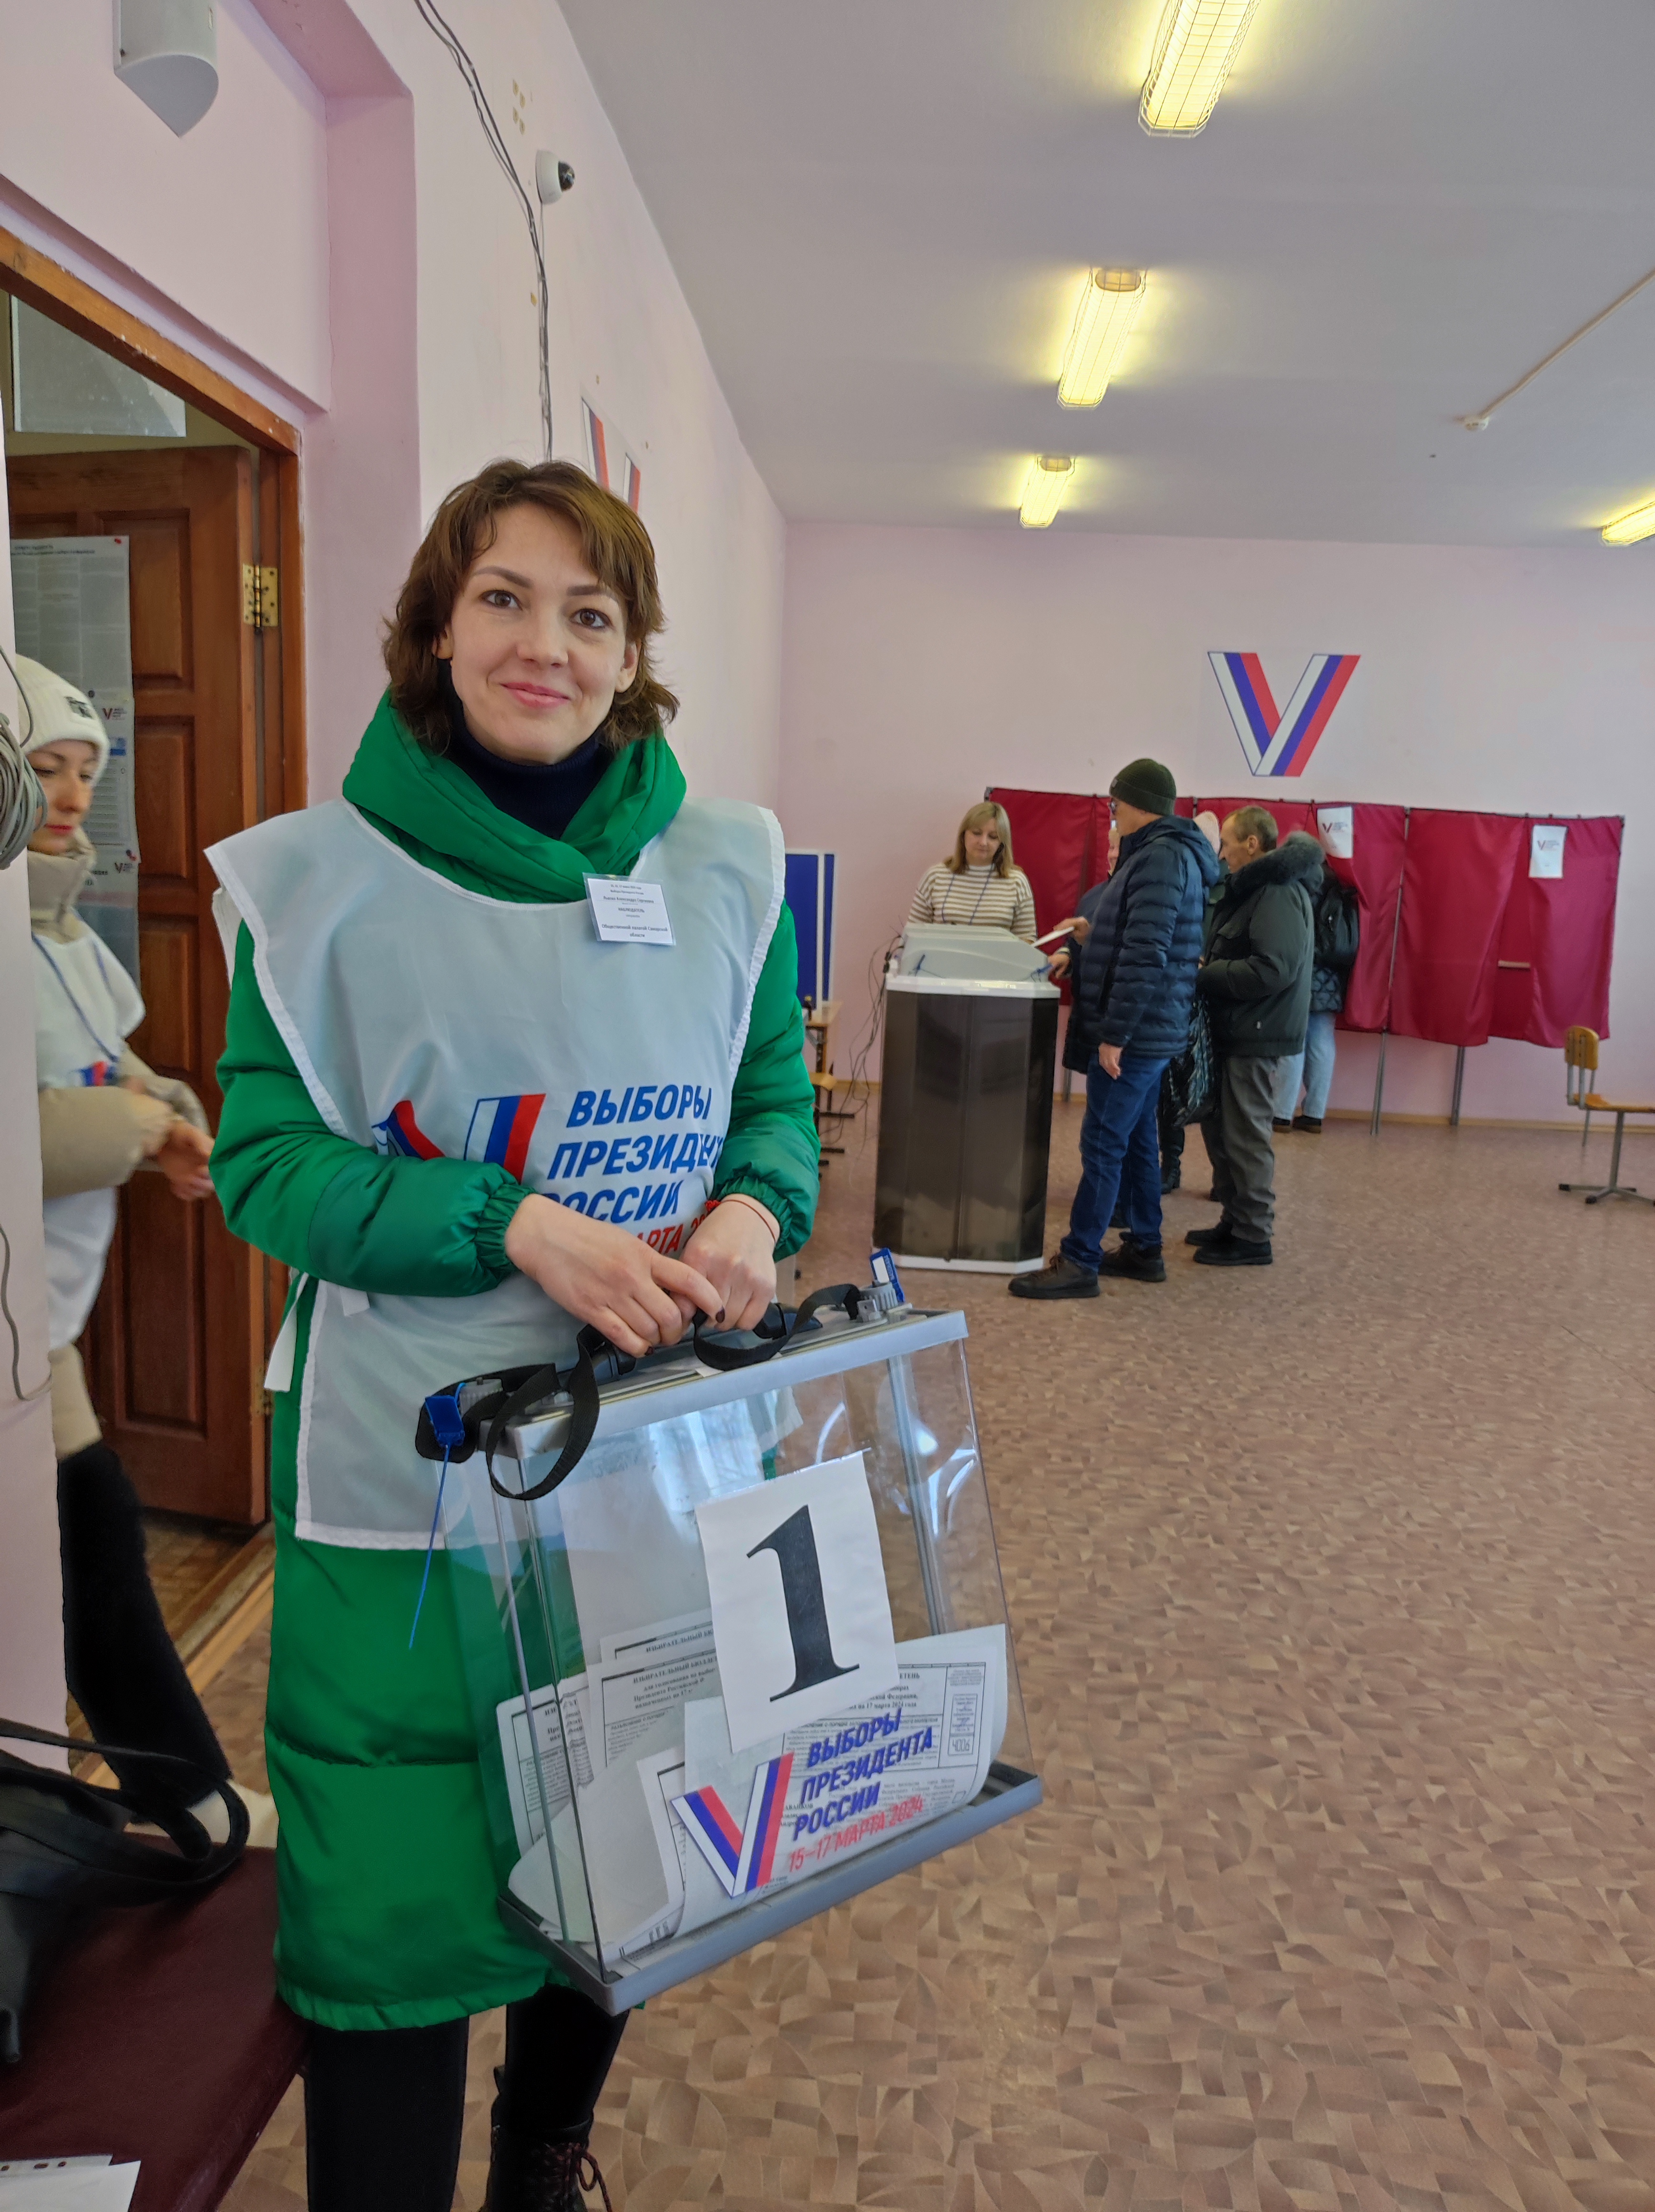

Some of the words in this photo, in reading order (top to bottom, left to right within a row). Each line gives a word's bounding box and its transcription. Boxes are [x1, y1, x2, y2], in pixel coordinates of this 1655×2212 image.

[566, 1085, 712, 1128] ВЫБОРЫ
[746, 1504, 860, 1702] 1
[800, 1726, 932, 1804] ПРЕЗИДЕНТА
[807, 1707, 902, 1768] ВЫБОРЫ
[793, 1781, 881, 1842] РОССИИ
[835, 1811, 886, 1852] МАРТА
